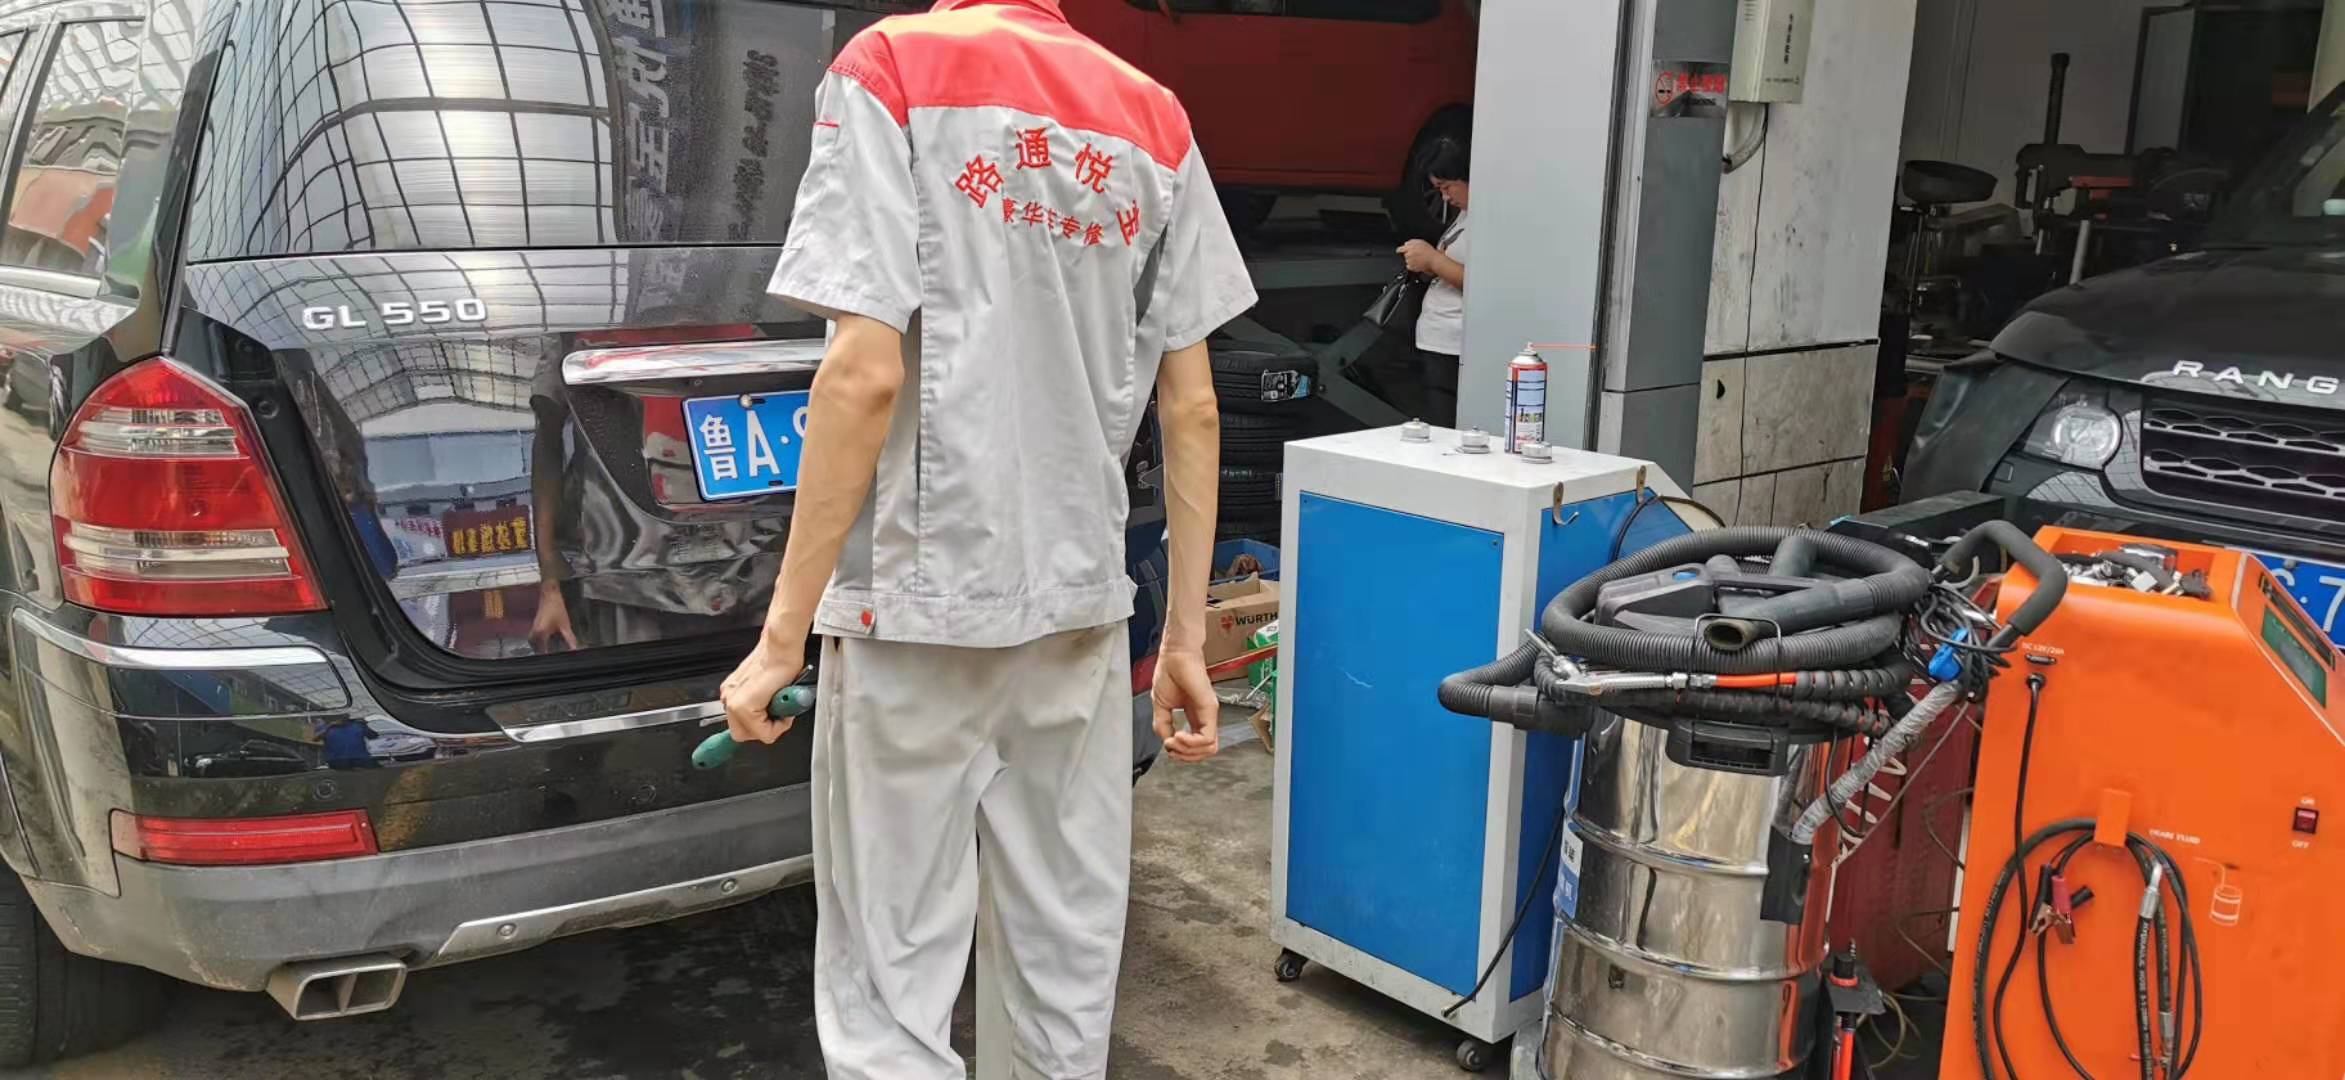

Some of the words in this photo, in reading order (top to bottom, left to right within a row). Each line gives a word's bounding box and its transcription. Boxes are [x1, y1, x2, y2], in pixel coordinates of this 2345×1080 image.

[302, 305, 368, 330] GL
[380, 298, 487, 325] 550
[2171, 359, 2340, 395] RANG
